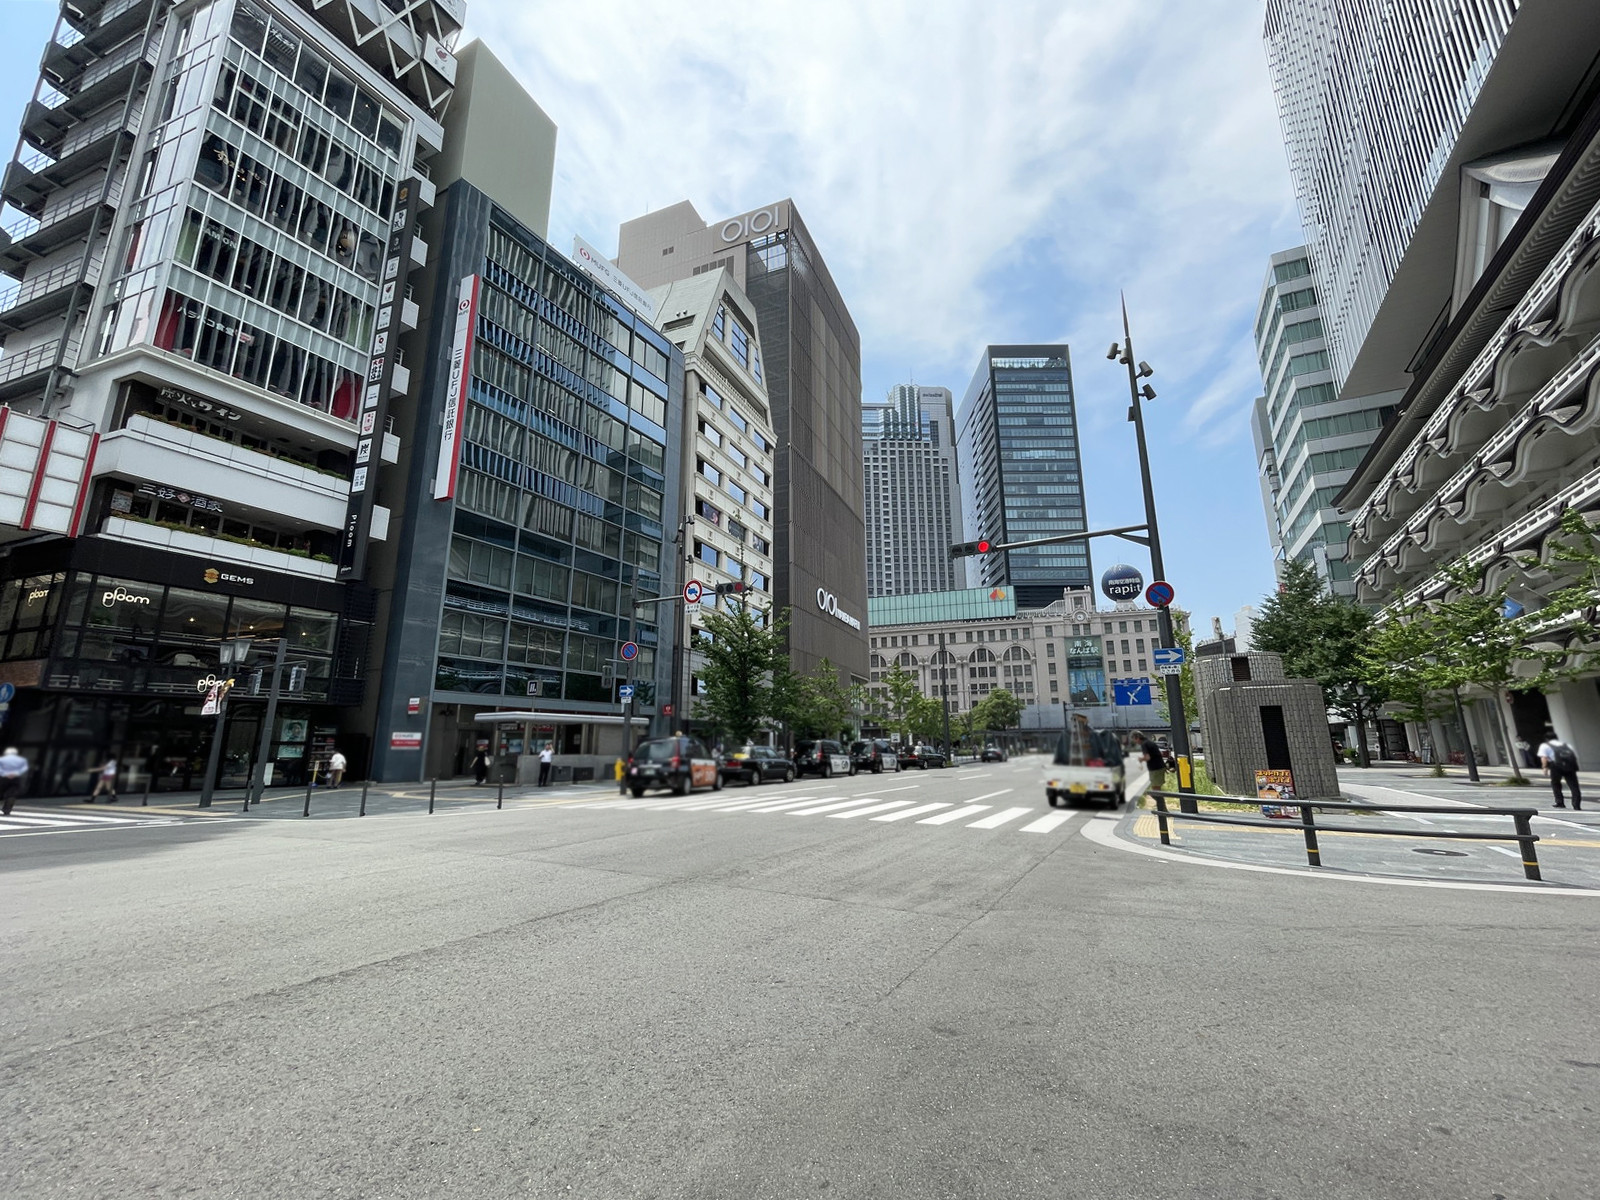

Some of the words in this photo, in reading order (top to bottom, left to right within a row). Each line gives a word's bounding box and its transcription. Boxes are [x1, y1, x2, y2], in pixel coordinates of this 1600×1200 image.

[590, 257, 610, 277] MUFG
[444, 348, 463, 441] 三菱UFJ信託銀行
[220, 573, 254, 585] GEMS
[102, 586, 150, 607] ploom
[1109, 584, 1141, 595] rapi:t
